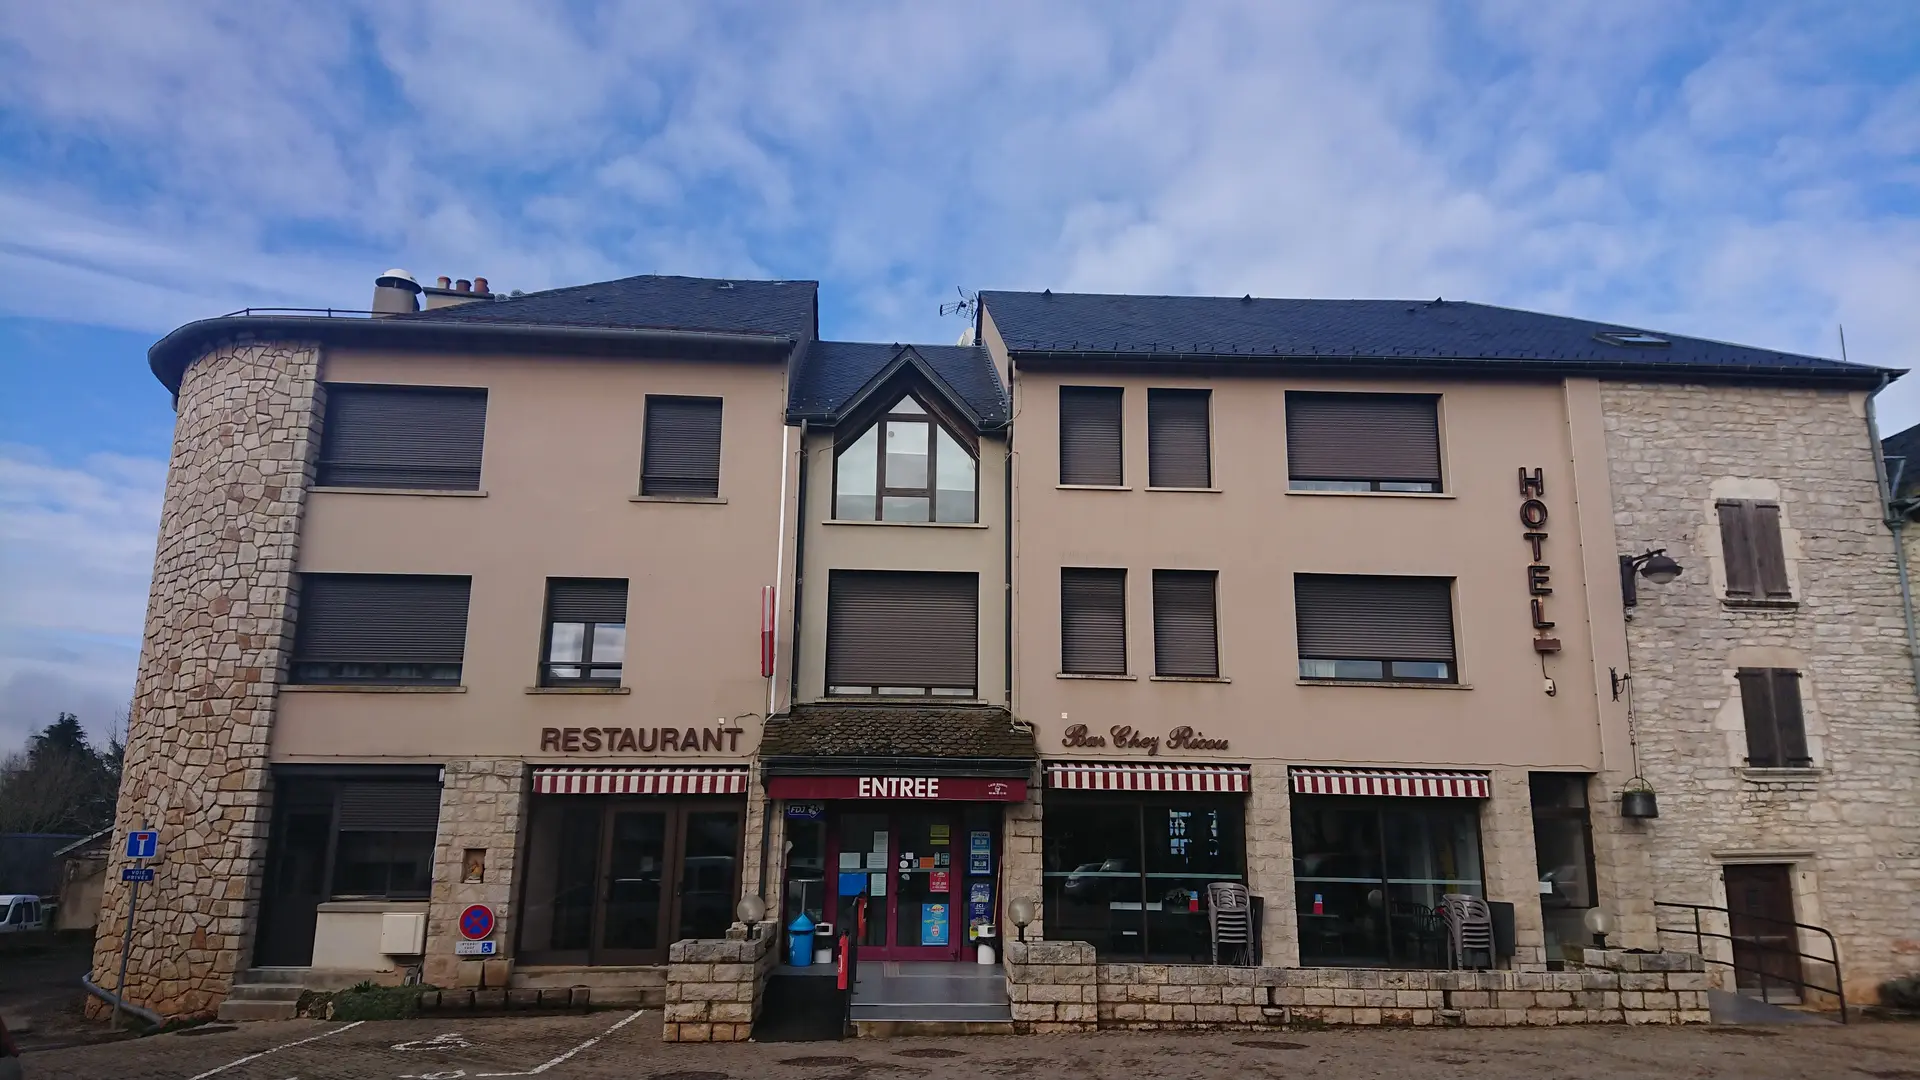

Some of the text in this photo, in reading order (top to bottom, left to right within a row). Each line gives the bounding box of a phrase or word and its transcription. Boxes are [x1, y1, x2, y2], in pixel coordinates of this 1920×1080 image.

[1518, 466, 1555, 629] HOTEL
[540, 727, 743, 751] RESTAURANT
[1062, 723, 1229, 756] Bar Chez Ricou
[858, 777, 939, 797] ENTREE
[790, 806, 806, 814] FDJ
